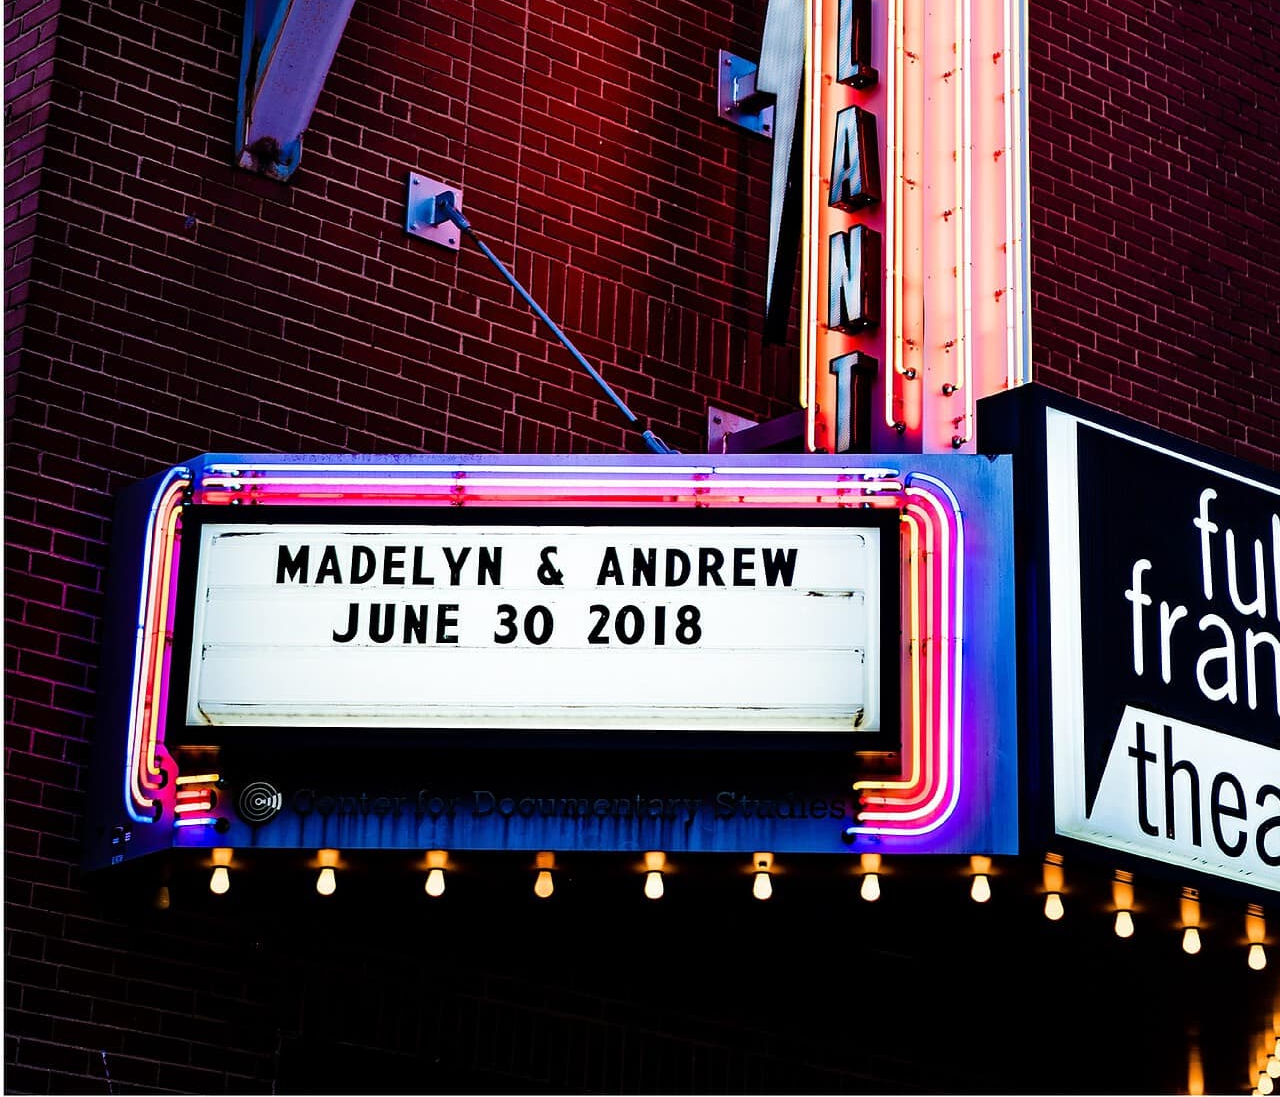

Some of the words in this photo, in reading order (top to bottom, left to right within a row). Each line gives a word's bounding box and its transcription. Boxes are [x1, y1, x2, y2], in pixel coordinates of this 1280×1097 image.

[275, 544, 503, 587] MADELYN
[536, 545, 565, 586] &
[596, 546, 799, 588] ANDREW
[332, 603, 460, 645] JUNE
[493, 603, 555, 645] 30
[587, 604, 703, 646] 2018
[472, 790, 704, 826] Documentary
[714, 790, 847, 820] Studies
